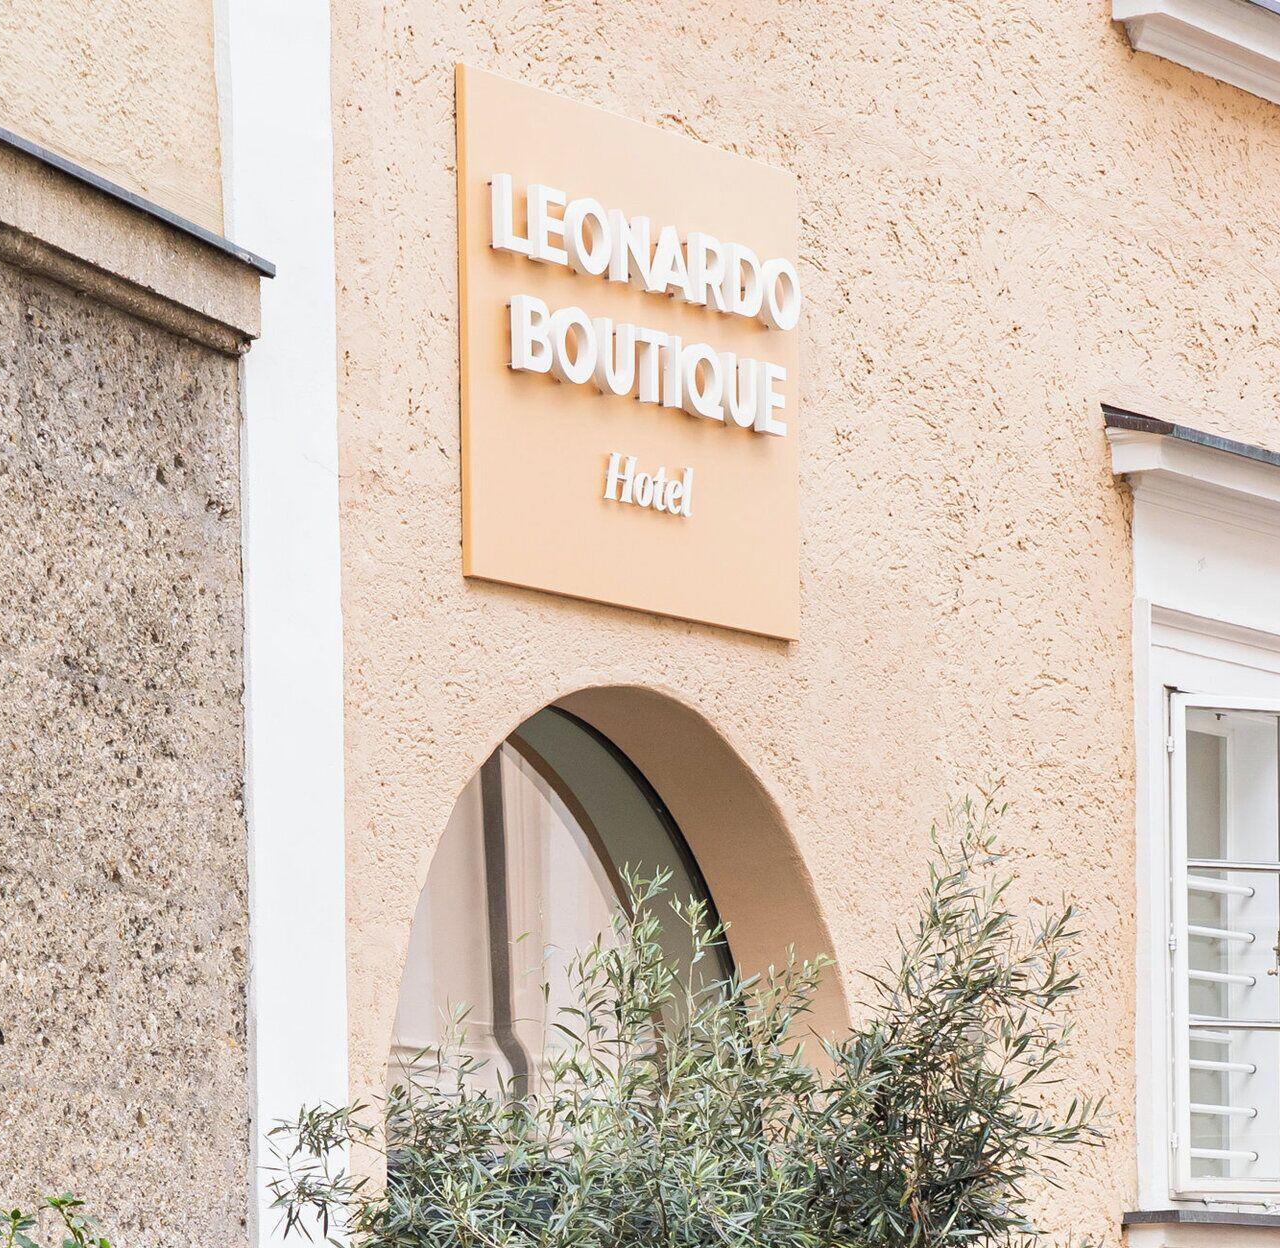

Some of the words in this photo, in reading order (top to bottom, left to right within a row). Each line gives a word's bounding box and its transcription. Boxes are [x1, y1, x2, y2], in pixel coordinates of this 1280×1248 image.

[492, 173, 802, 332] LEONARDO
[510, 294, 788, 437] BOUTIQUE
[603, 452, 694, 518] Hotel
